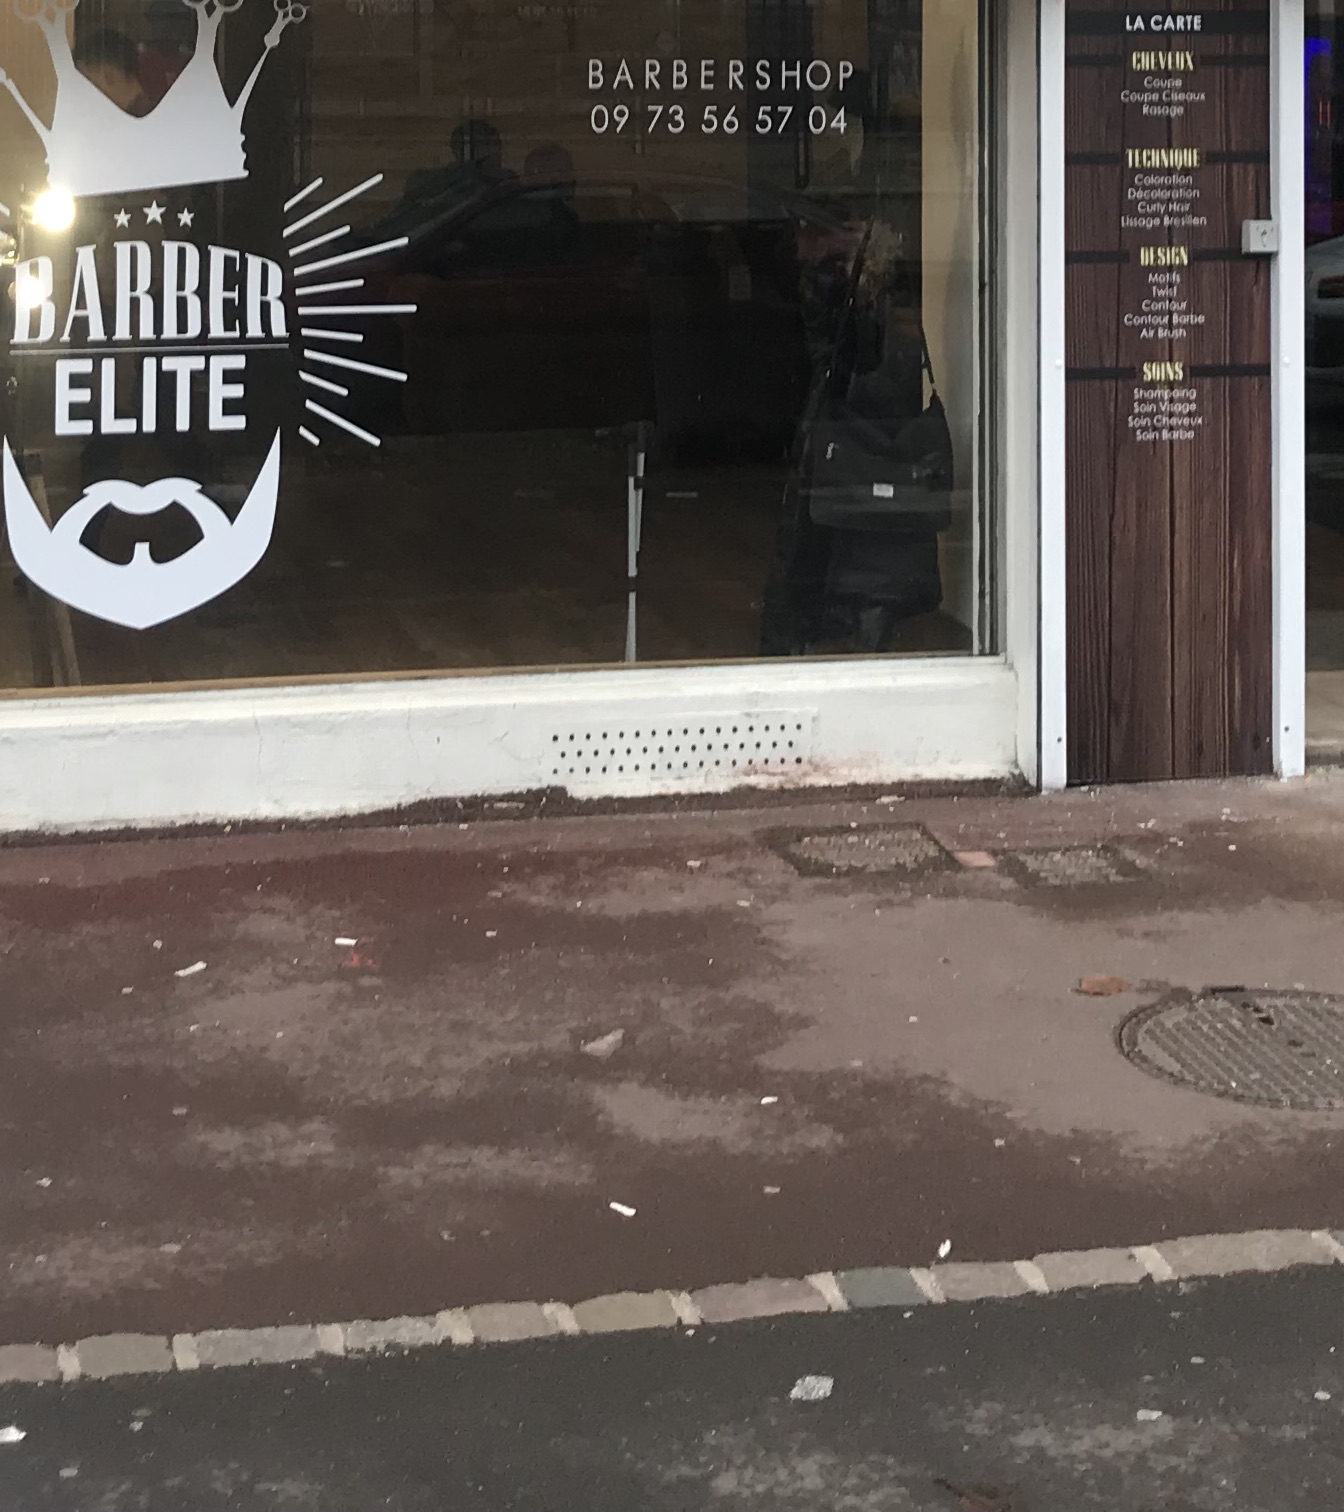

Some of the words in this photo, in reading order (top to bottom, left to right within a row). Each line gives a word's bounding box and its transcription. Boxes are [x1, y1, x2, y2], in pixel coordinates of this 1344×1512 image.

[1126, 15, 1145, 32] LA
[1150, 14, 1202, 31] CARTE
[1132, 51, 1194, 72] CHEVEUX
[588, 58, 853, 91] BARBERSHOP
[1144, 76, 1182, 90] Coupe
[1121, 90, 1159, 104] Coupe
[1142, 103, 1184, 118] Rasage
[591, 105, 629, 134] 09
[647, 105, 685, 134] 73
[701, 105, 739, 134] 56
[756, 105, 793, 135] 57
[808, 105, 847, 135] 04
[1126, 148, 1200, 170] TECHNIQUE
[1134, 173, 1193, 187] Coloration
[1138, 201, 1167, 214] Curly
[1140, 246, 1189, 266] DESIGN
[10, 240, 289, 344] BARBER
[1142, 300, 1187, 312] Contour
[1124, 314, 1169, 326] Contour
[1143, 361, 1184, 382] SOINS
[55, 354, 246, 436] ELITE
[1134, 401, 1156, 413] Soin
[1128, 416, 1151, 428] Soin
[1136, 429, 1159, 441] Soin
